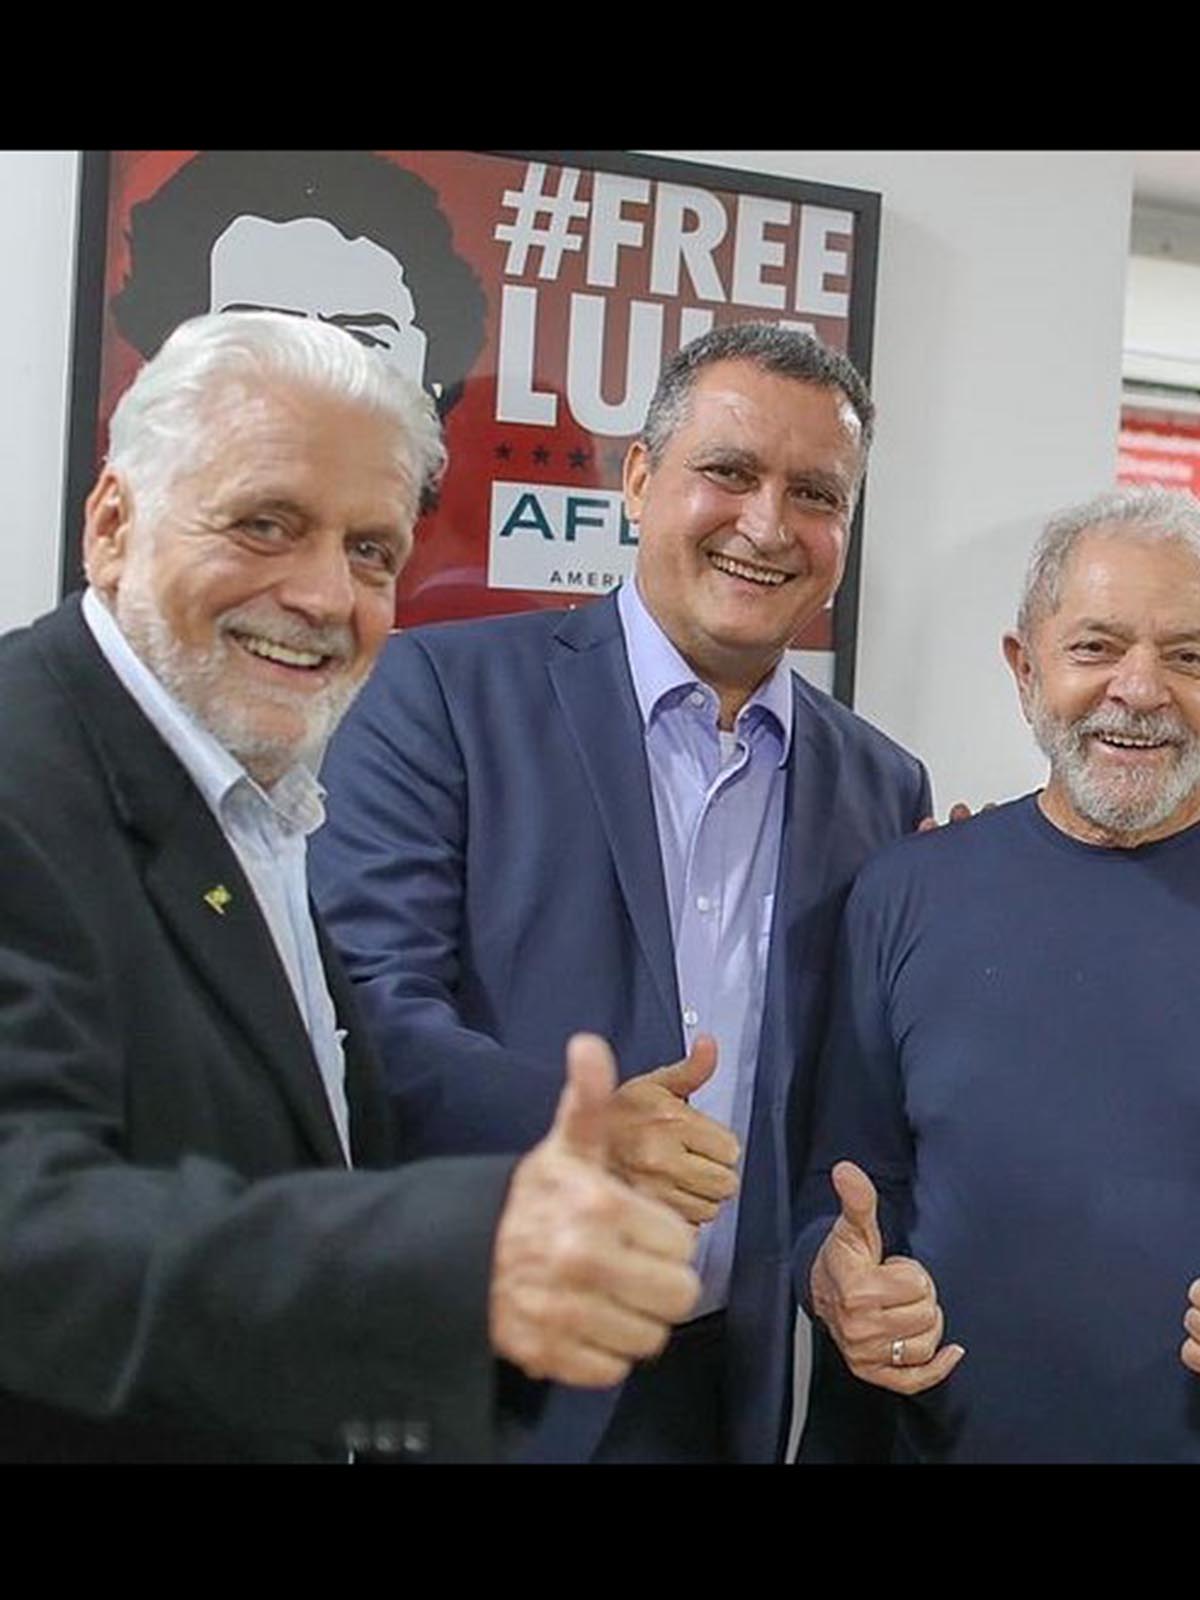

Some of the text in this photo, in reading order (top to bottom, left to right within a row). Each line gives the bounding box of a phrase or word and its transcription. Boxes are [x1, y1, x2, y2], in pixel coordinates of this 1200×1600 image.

[494, 162, 855, 318] #FREE
[495, 284, 816, 437] LU
[499, 493, 640, 546] AFL
[549, 569, 624, 587] AMERI
